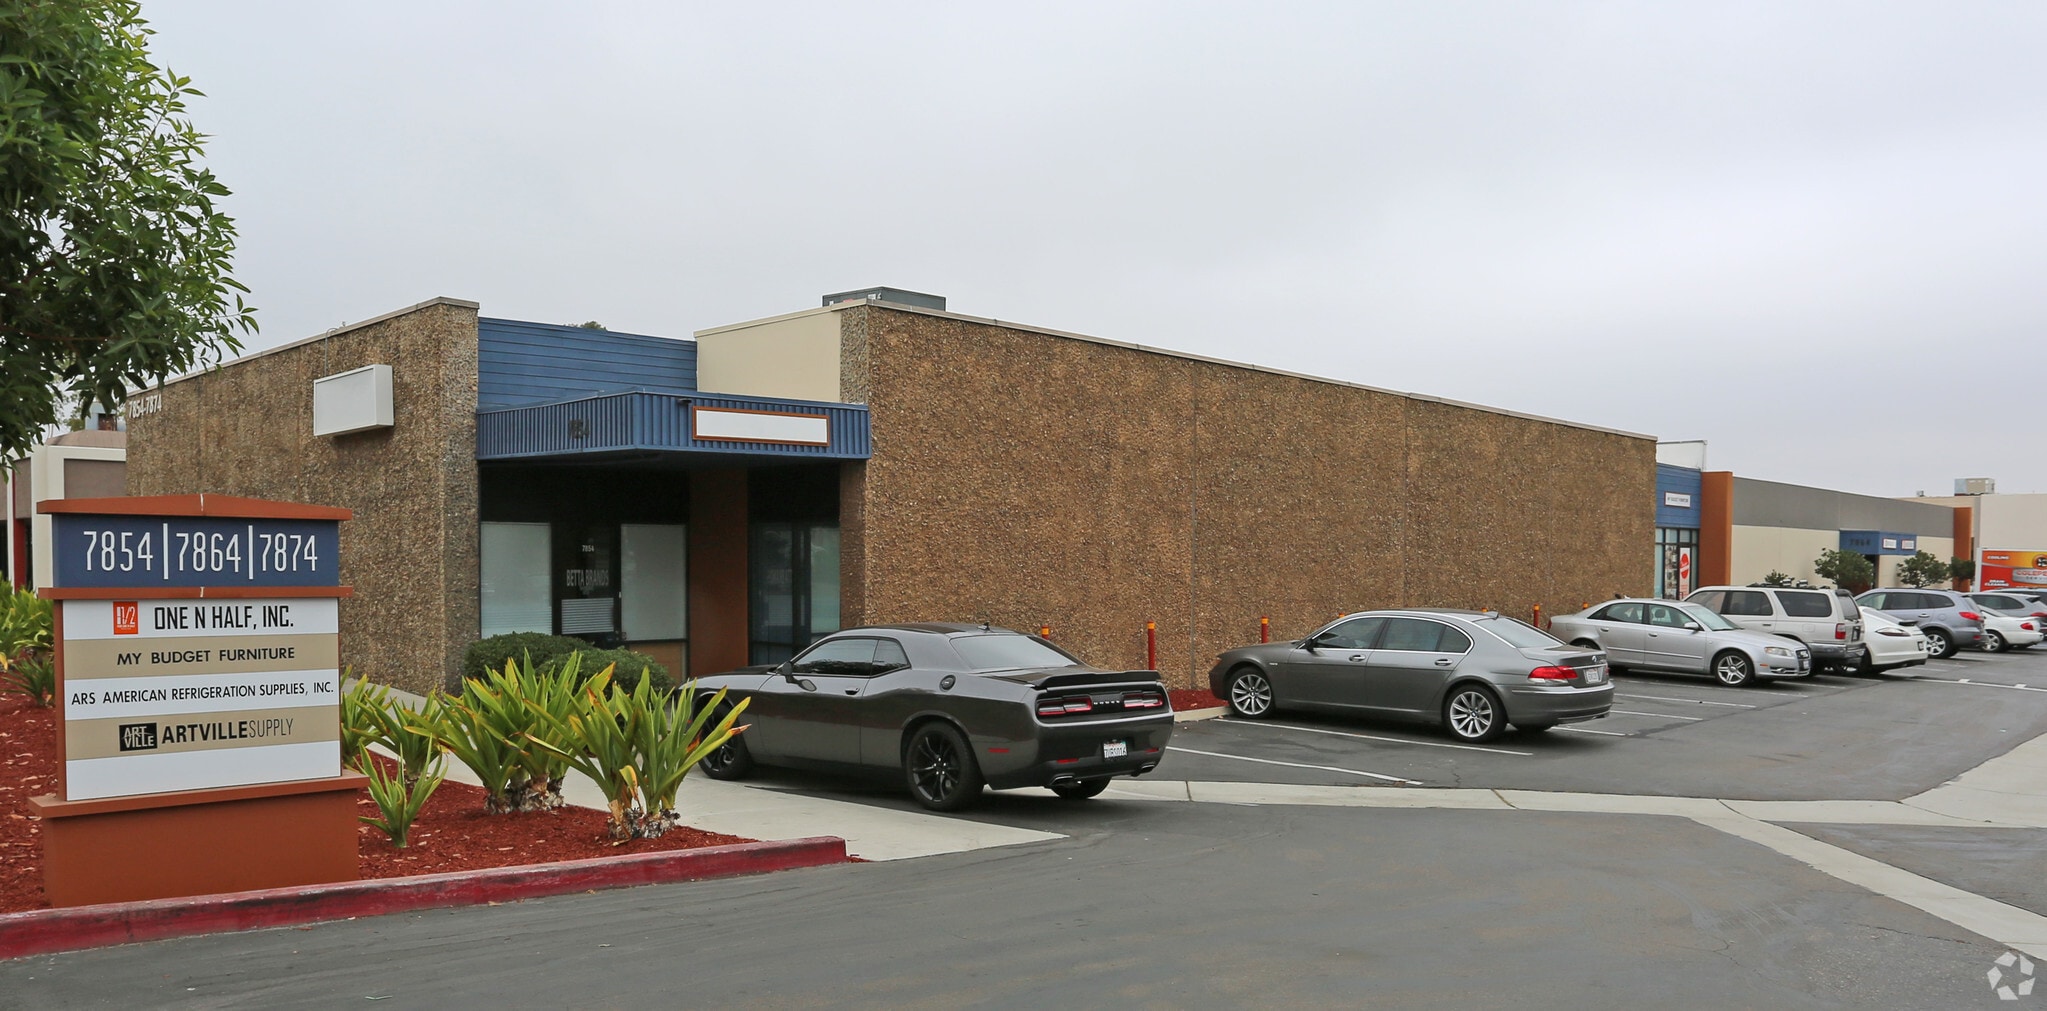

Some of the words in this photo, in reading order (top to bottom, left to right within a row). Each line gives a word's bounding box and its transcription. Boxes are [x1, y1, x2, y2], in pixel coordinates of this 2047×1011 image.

[83, 530, 154, 572] 7854
[176, 532, 242, 572] 7864
[259, 532, 318, 572] 7874
[566, 569, 585, 587] BETTA
[585, 569, 609, 587] BRANDS
[154, 606, 189, 630] ONE
[195, 606, 206, 629] N
[212, 605, 257, 630] HALF,
[263, 605, 294, 628] INC.
[117, 652, 142, 665] MY
[151, 650, 211, 664] BUDGET
[219, 647, 296, 662] FURNITURE
[71, 692, 96, 706] ARS
[102, 689, 167, 704] AMERICAN
[171, 685, 256, 701] REFRIGERATION
[259, 682, 309, 697] SUPPLIES,
[313, 681, 334, 694] INC.
[124, 726, 147, 738] ART
